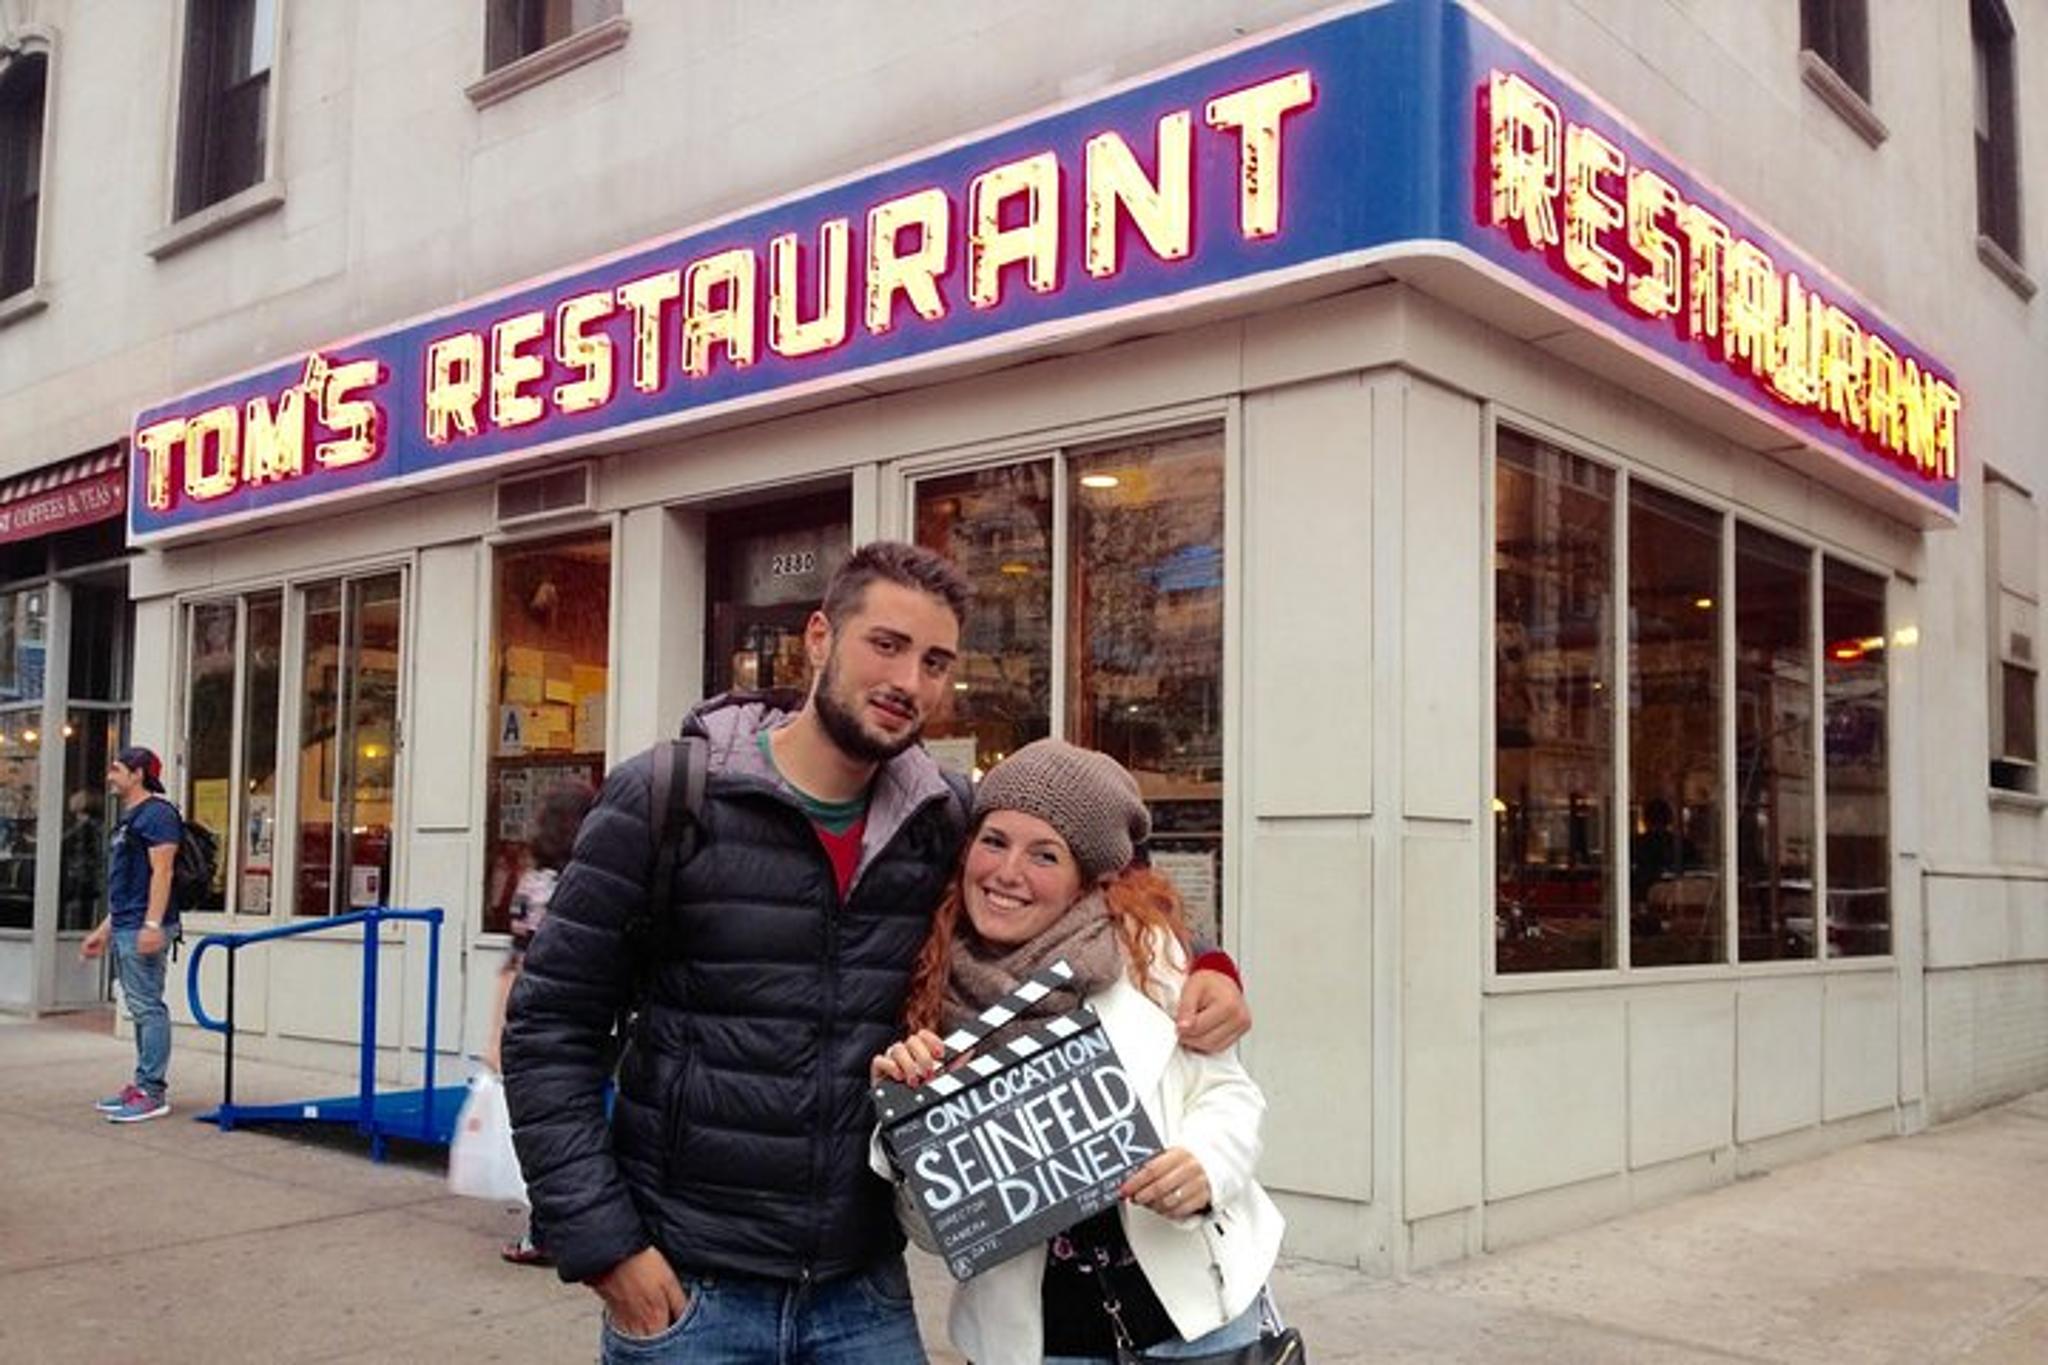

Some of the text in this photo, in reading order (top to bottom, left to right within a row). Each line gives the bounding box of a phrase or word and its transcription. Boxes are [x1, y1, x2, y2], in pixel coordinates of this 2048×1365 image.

[138, 70, 1314, 511] TOM'S RESTAURANT
[1490, 68, 1962, 480] RESTAURANT
[14, 498, 65, 526] COFFEES
[67, 494, 80, 514] &
[79, 486, 111, 513] TEAS
[503, 711, 520, 742] A
[925, 1027, 1110, 1134] ON LOCATION
[915, 1066, 1137, 1210] SEINFELD
[997, 1120, 1153, 1224] DINER
